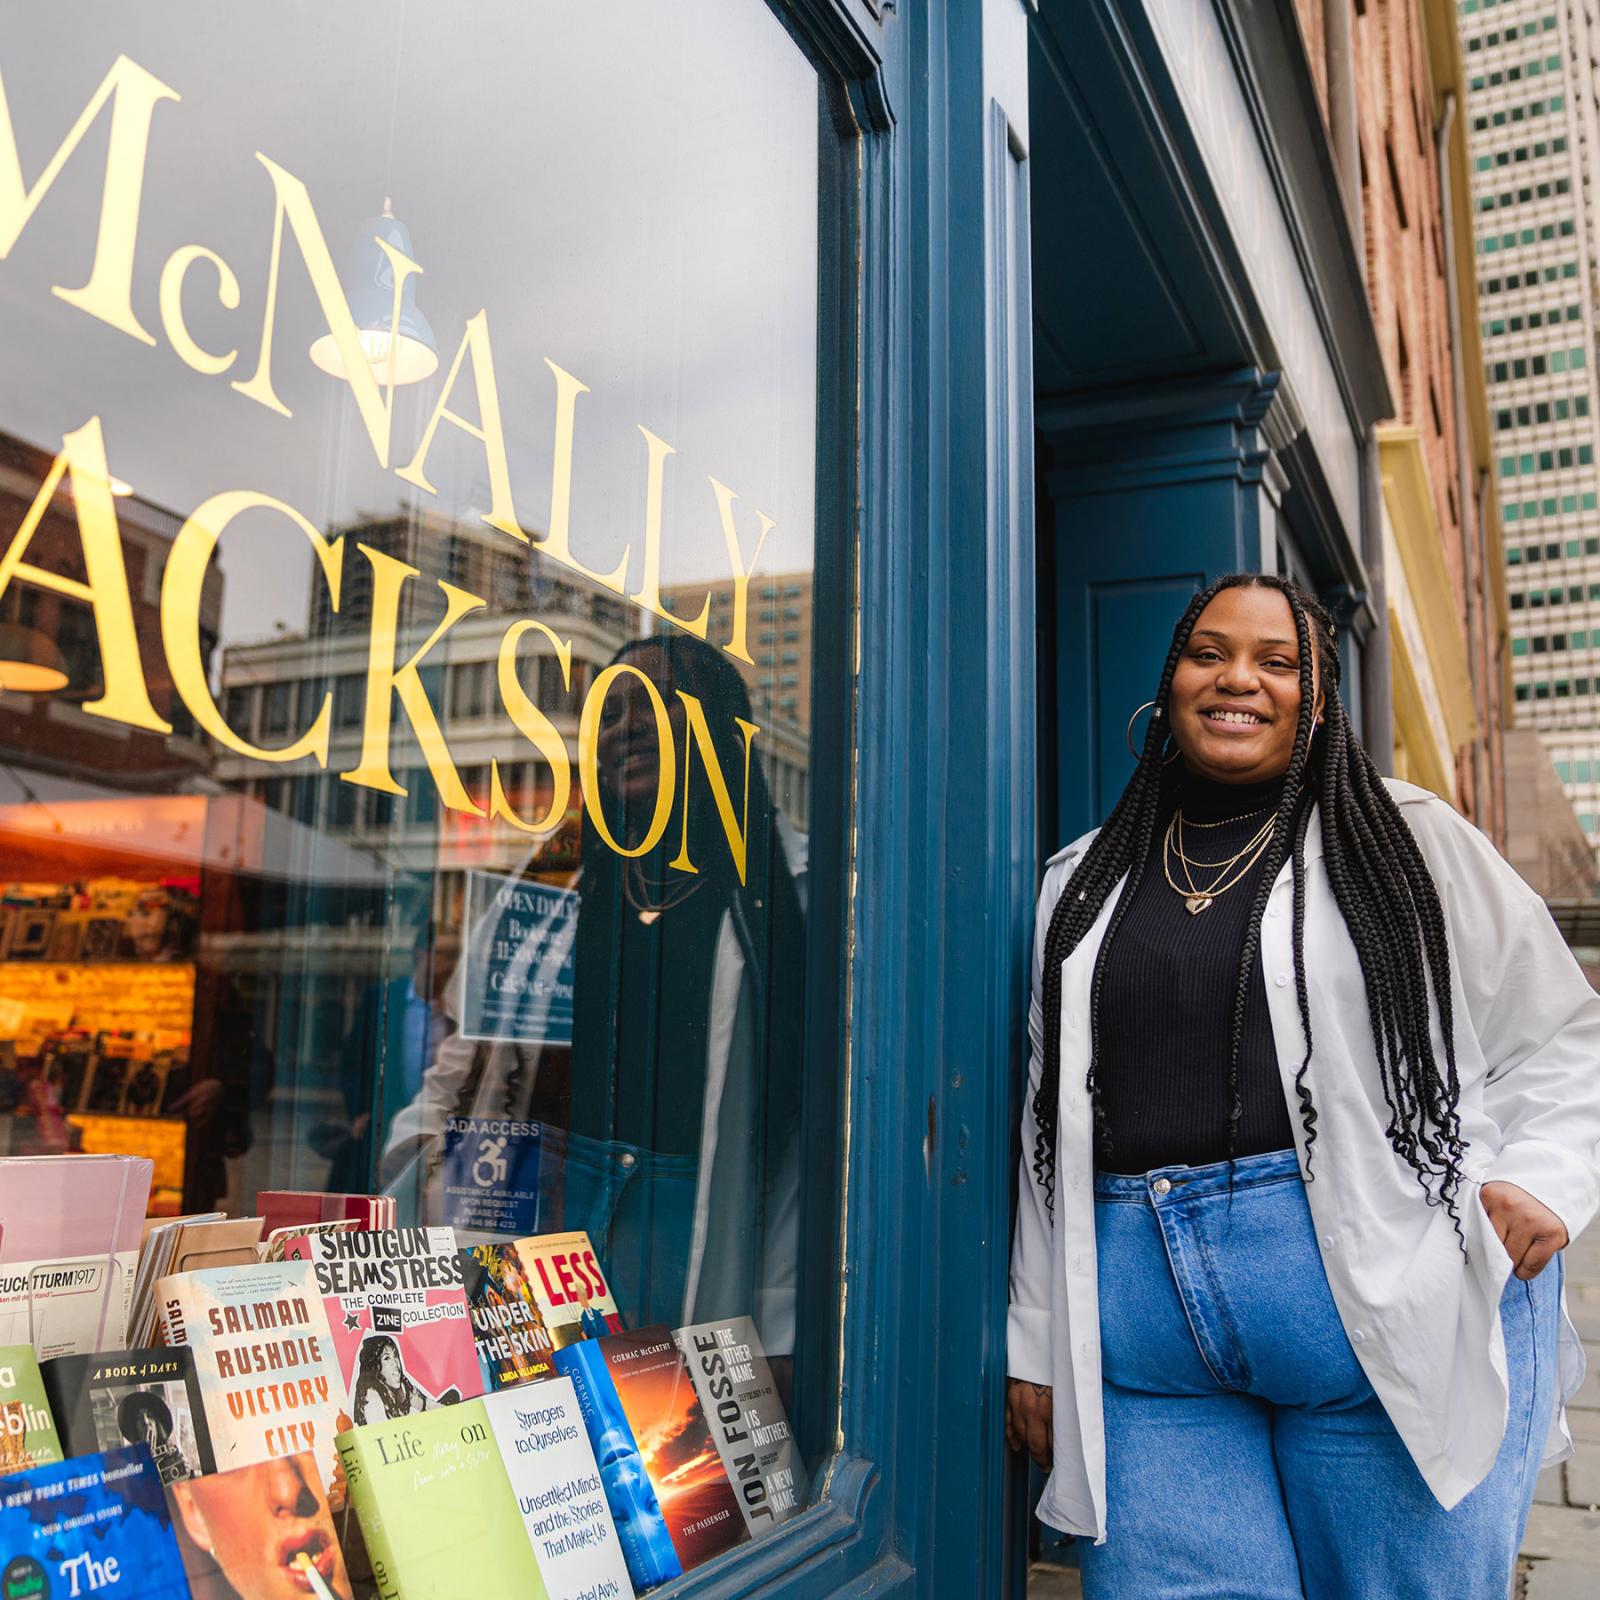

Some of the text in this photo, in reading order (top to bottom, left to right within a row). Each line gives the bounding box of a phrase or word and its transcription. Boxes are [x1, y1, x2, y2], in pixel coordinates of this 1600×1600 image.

[449, 1121, 540, 1137] ADA ACCESS
[482, 1199, 519, 1208] REQUEST
[492, 1190, 535, 1200] AVAILABLE
[494, 1209, 515, 1219] CALL
[319, 1226, 431, 1260] SHOTGUN
[314, 1254, 464, 1295] SEAMSTRESS
[534, 1251, 608, 1307] LESS
[342, 1292, 425, 1310] THE COMPLETE
[376, 1303, 465, 1327] ZINE COLLECTION
[208, 1297, 310, 1337] SALMAN
[473, 1300, 535, 1332] UNDER
[475, 1327, 552, 1364] THE SKIN
[716, 1328, 737, 1345] THE
[215, 1336, 322, 1379] RUSHDIE
[611, 1342, 671, 1364] CORMAC McCARTHY
[723, 1345, 753, 1364] OTHER
[92, 1370, 101, 1380] A
[104, 1365, 137, 1379] BOOK
[149, 1361, 178, 1374] DAYS
[499, 1372, 519, 1383] LINDA
[519, 1362, 550, 1379] VILLAROSA
[728, 1362, 756, 1384] NAME
[226, 1375, 329, 1420] VICTORY
[572, 1368, 595, 1416] CORMAC
[694, 1331, 749, 1445] FOSSE
[515, 1405, 565, 1431] Strangers
[744, 1409, 761, 1429] I IS
[264, 1420, 315, 1457] CITY
[376, 1423, 487, 1466] Life on
[751, 1421, 790, 1448] ANOTHER
[341, 1446, 362, 1485] Life
[6, 1490, 33, 1508] NEW
[35, 1481, 65, 1501] YORK
[67, 1473, 99, 1493] TIMES
[519, 1474, 600, 1515] Unsettled Minds
[733, 1452, 775, 1522] JON
[766, 1468, 794, 1494] A NEW
[771, 1489, 798, 1513] NAME
[533, 1513, 555, 1537] and
[569, 1500, 604, 1524] Stories
[683, 1508, 731, 1537] THE PASSENGER
[543, 1538, 567, 1559] That
[566, 1529, 593, 1550] Make
[59, 1551, 121, 1598] The
[375, 1561, 389, 1587] on
